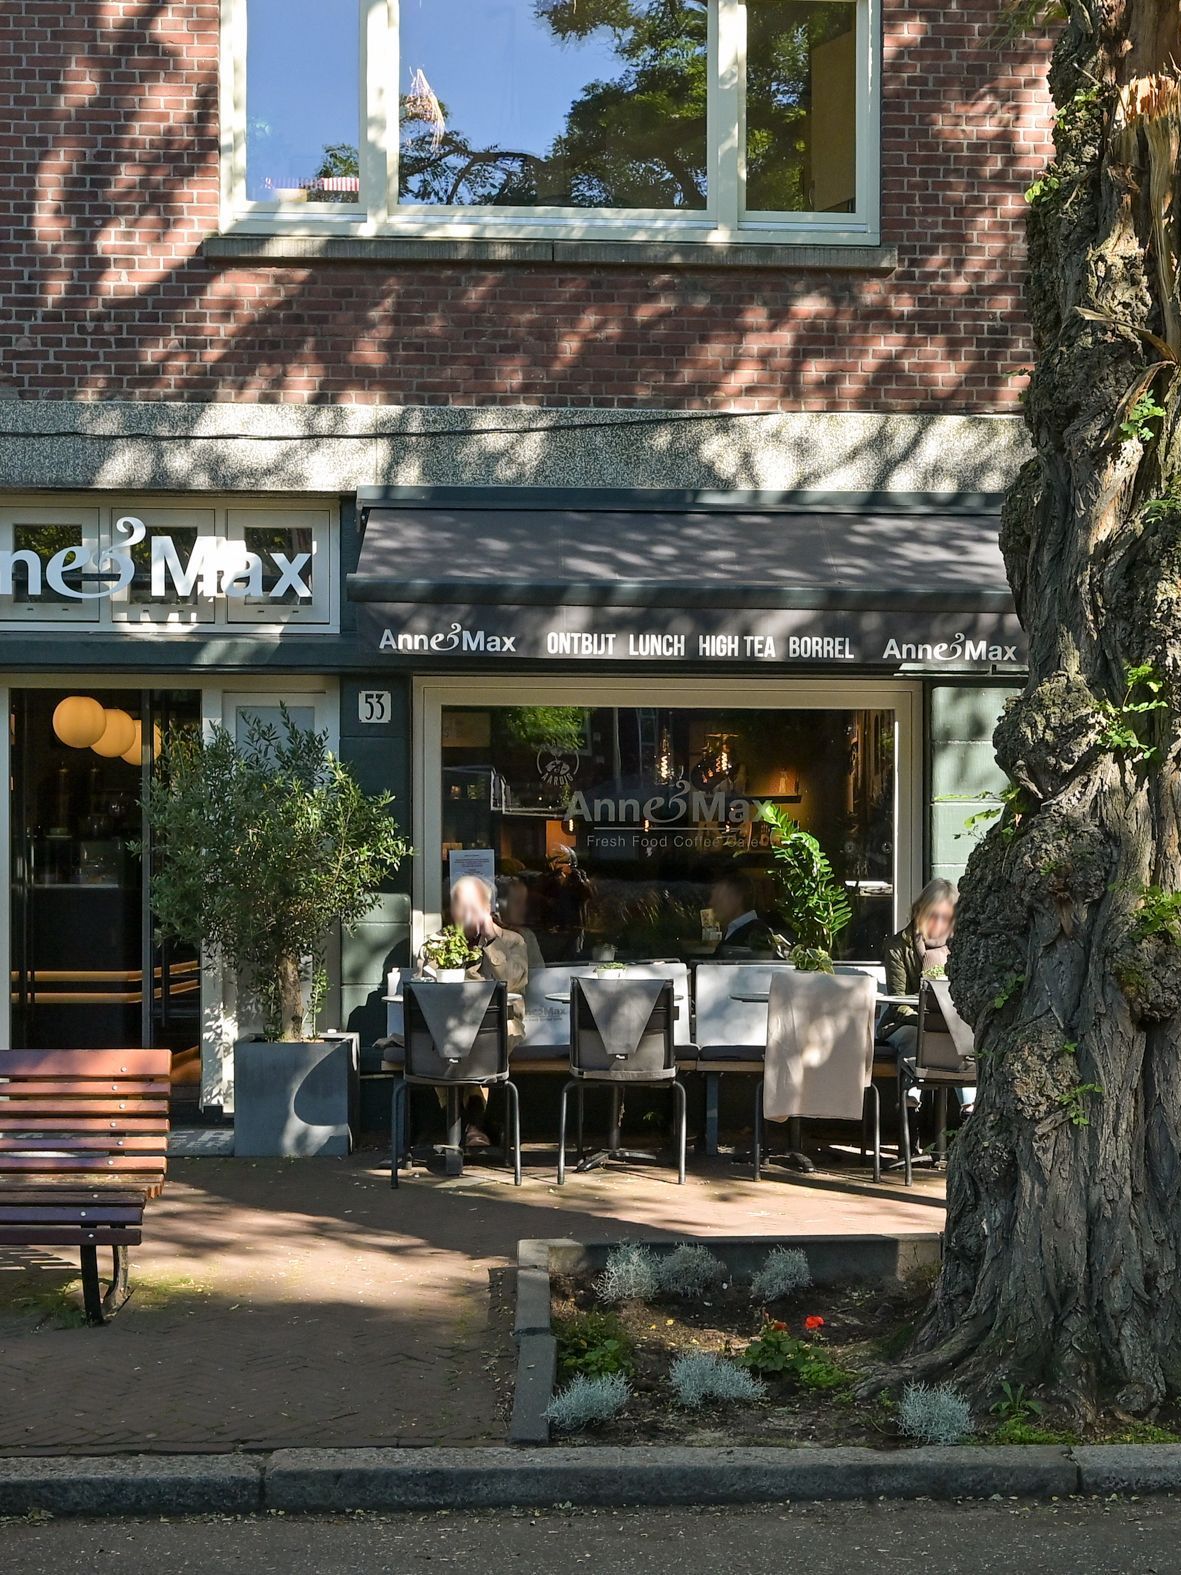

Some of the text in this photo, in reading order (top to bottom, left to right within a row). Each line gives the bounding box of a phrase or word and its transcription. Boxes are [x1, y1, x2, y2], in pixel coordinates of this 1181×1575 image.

[547, 631, 616, 656] ONTBIJT
[629, 632, 686, 657] LUNCH
[699, 634, 739, 658] HIGH
[744, 635, 776, 658] TEA
[789, 637, 854, 660] BORREL
[365, 693, 385, 721] 53
[586, 835, 626, 848] Fresh
[632, 835, 668, 848] Food
